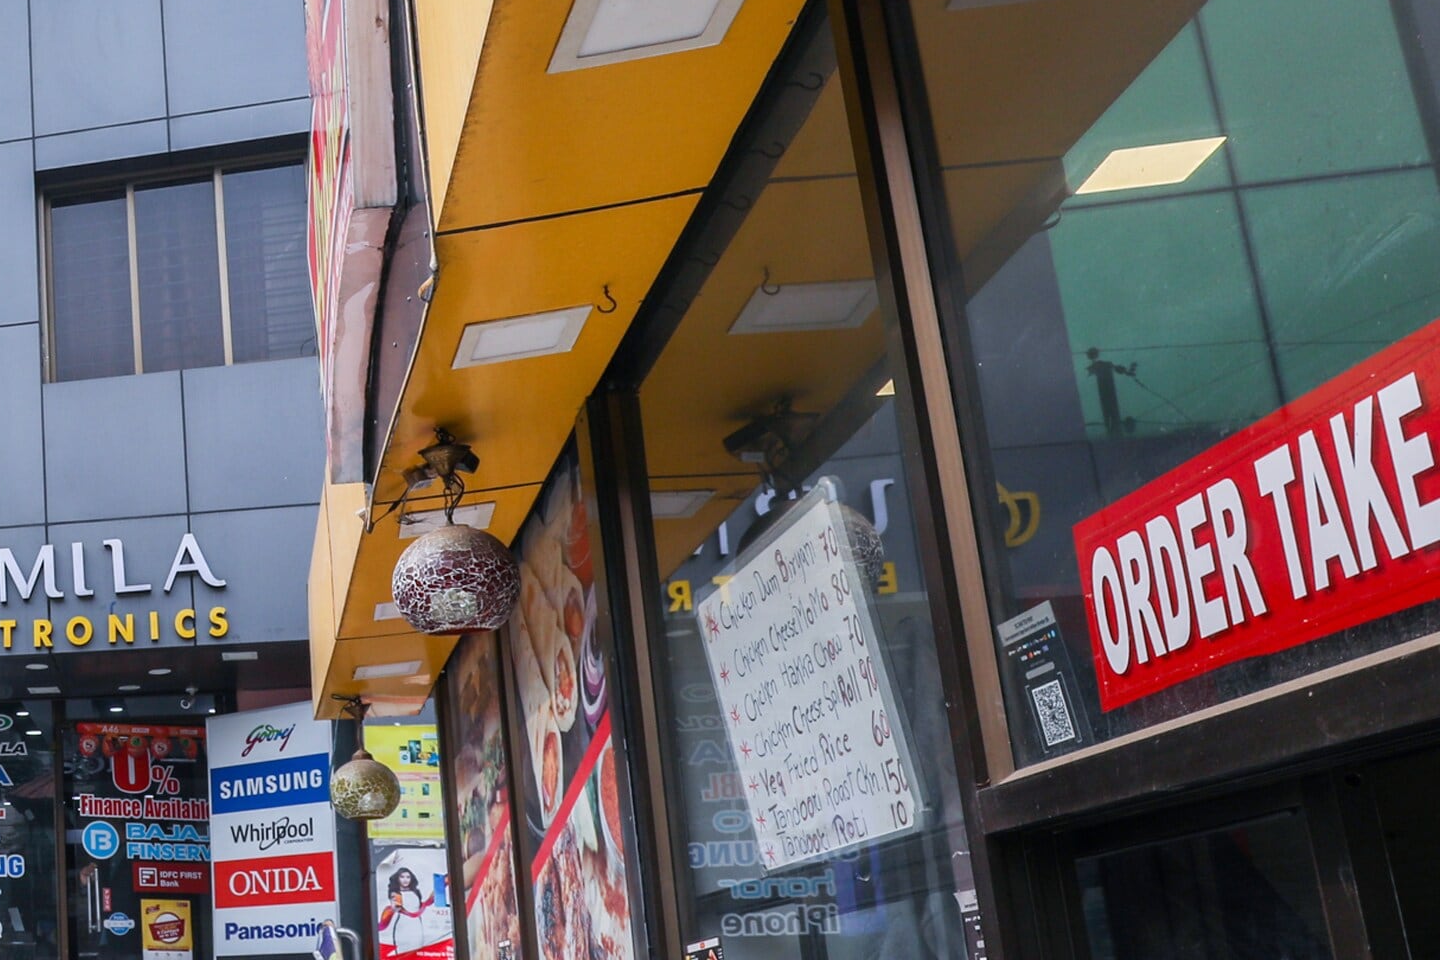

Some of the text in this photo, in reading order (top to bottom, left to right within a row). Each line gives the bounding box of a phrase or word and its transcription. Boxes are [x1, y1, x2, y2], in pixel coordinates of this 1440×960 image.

[1091, 372, 1440, 675] ORDER TAKE
[819, 525, 838, 563] 70
[831, 569, 850, 606] 80
[843, 614, 864, 654] 70
[859, 656, 877, 698] 90
[241, 723, 296, 757] Godrej
[819, 733, 852, 765] Rice
[871, 709, 890, 747] 60
[219, 769, 323, 800] SAMSUNG
[79, 793, 143, 818] Finance
[831, 808, 868, 846] Roti
[889, 799, 908, 829] 10
[230, 817, 313, 848] Whirlpool
[228, 865, 323, 897] ONIDA
